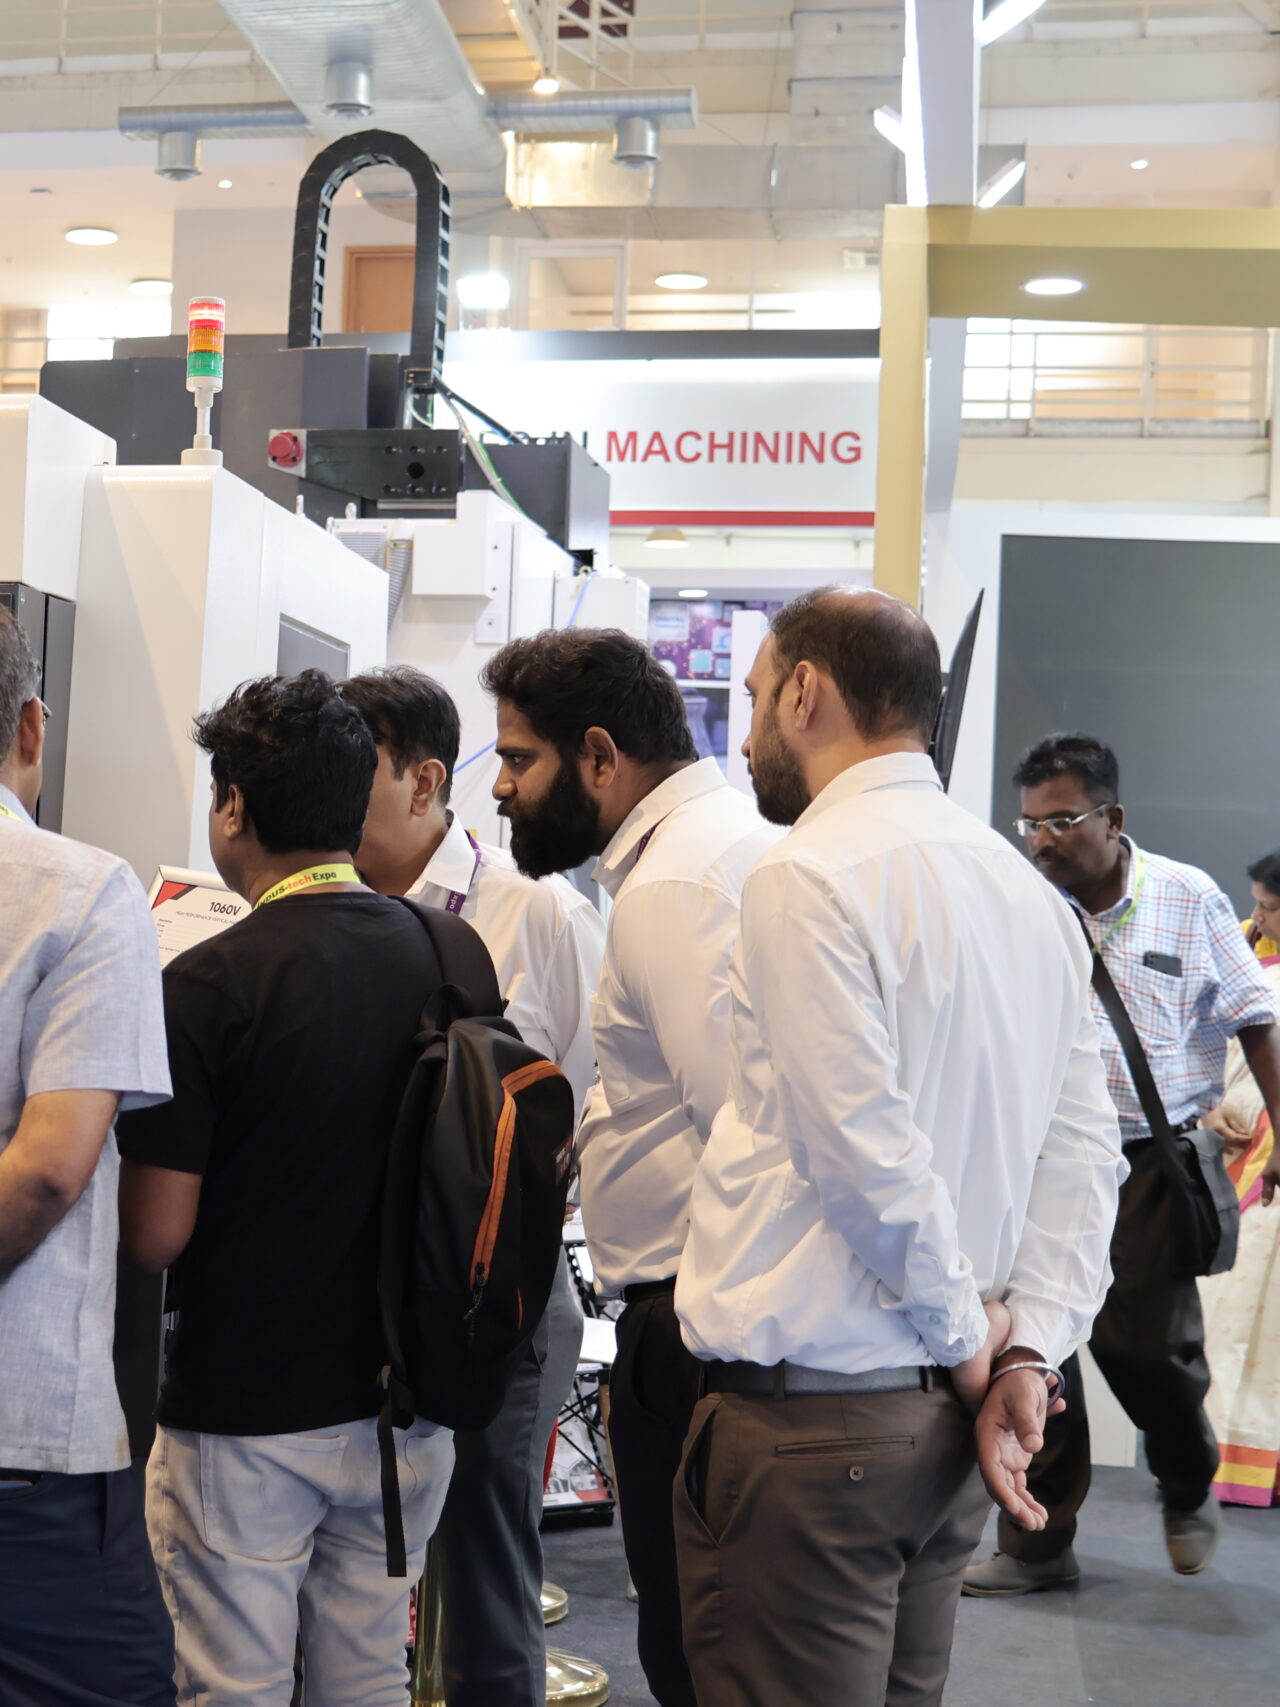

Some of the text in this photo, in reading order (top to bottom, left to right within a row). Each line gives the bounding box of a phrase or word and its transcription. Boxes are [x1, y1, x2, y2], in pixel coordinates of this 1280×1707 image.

[606, 431, 862, 464] MACHINING
[312, 872, 337, 881] Expo
[209, 901, 241, 916] 1060V
